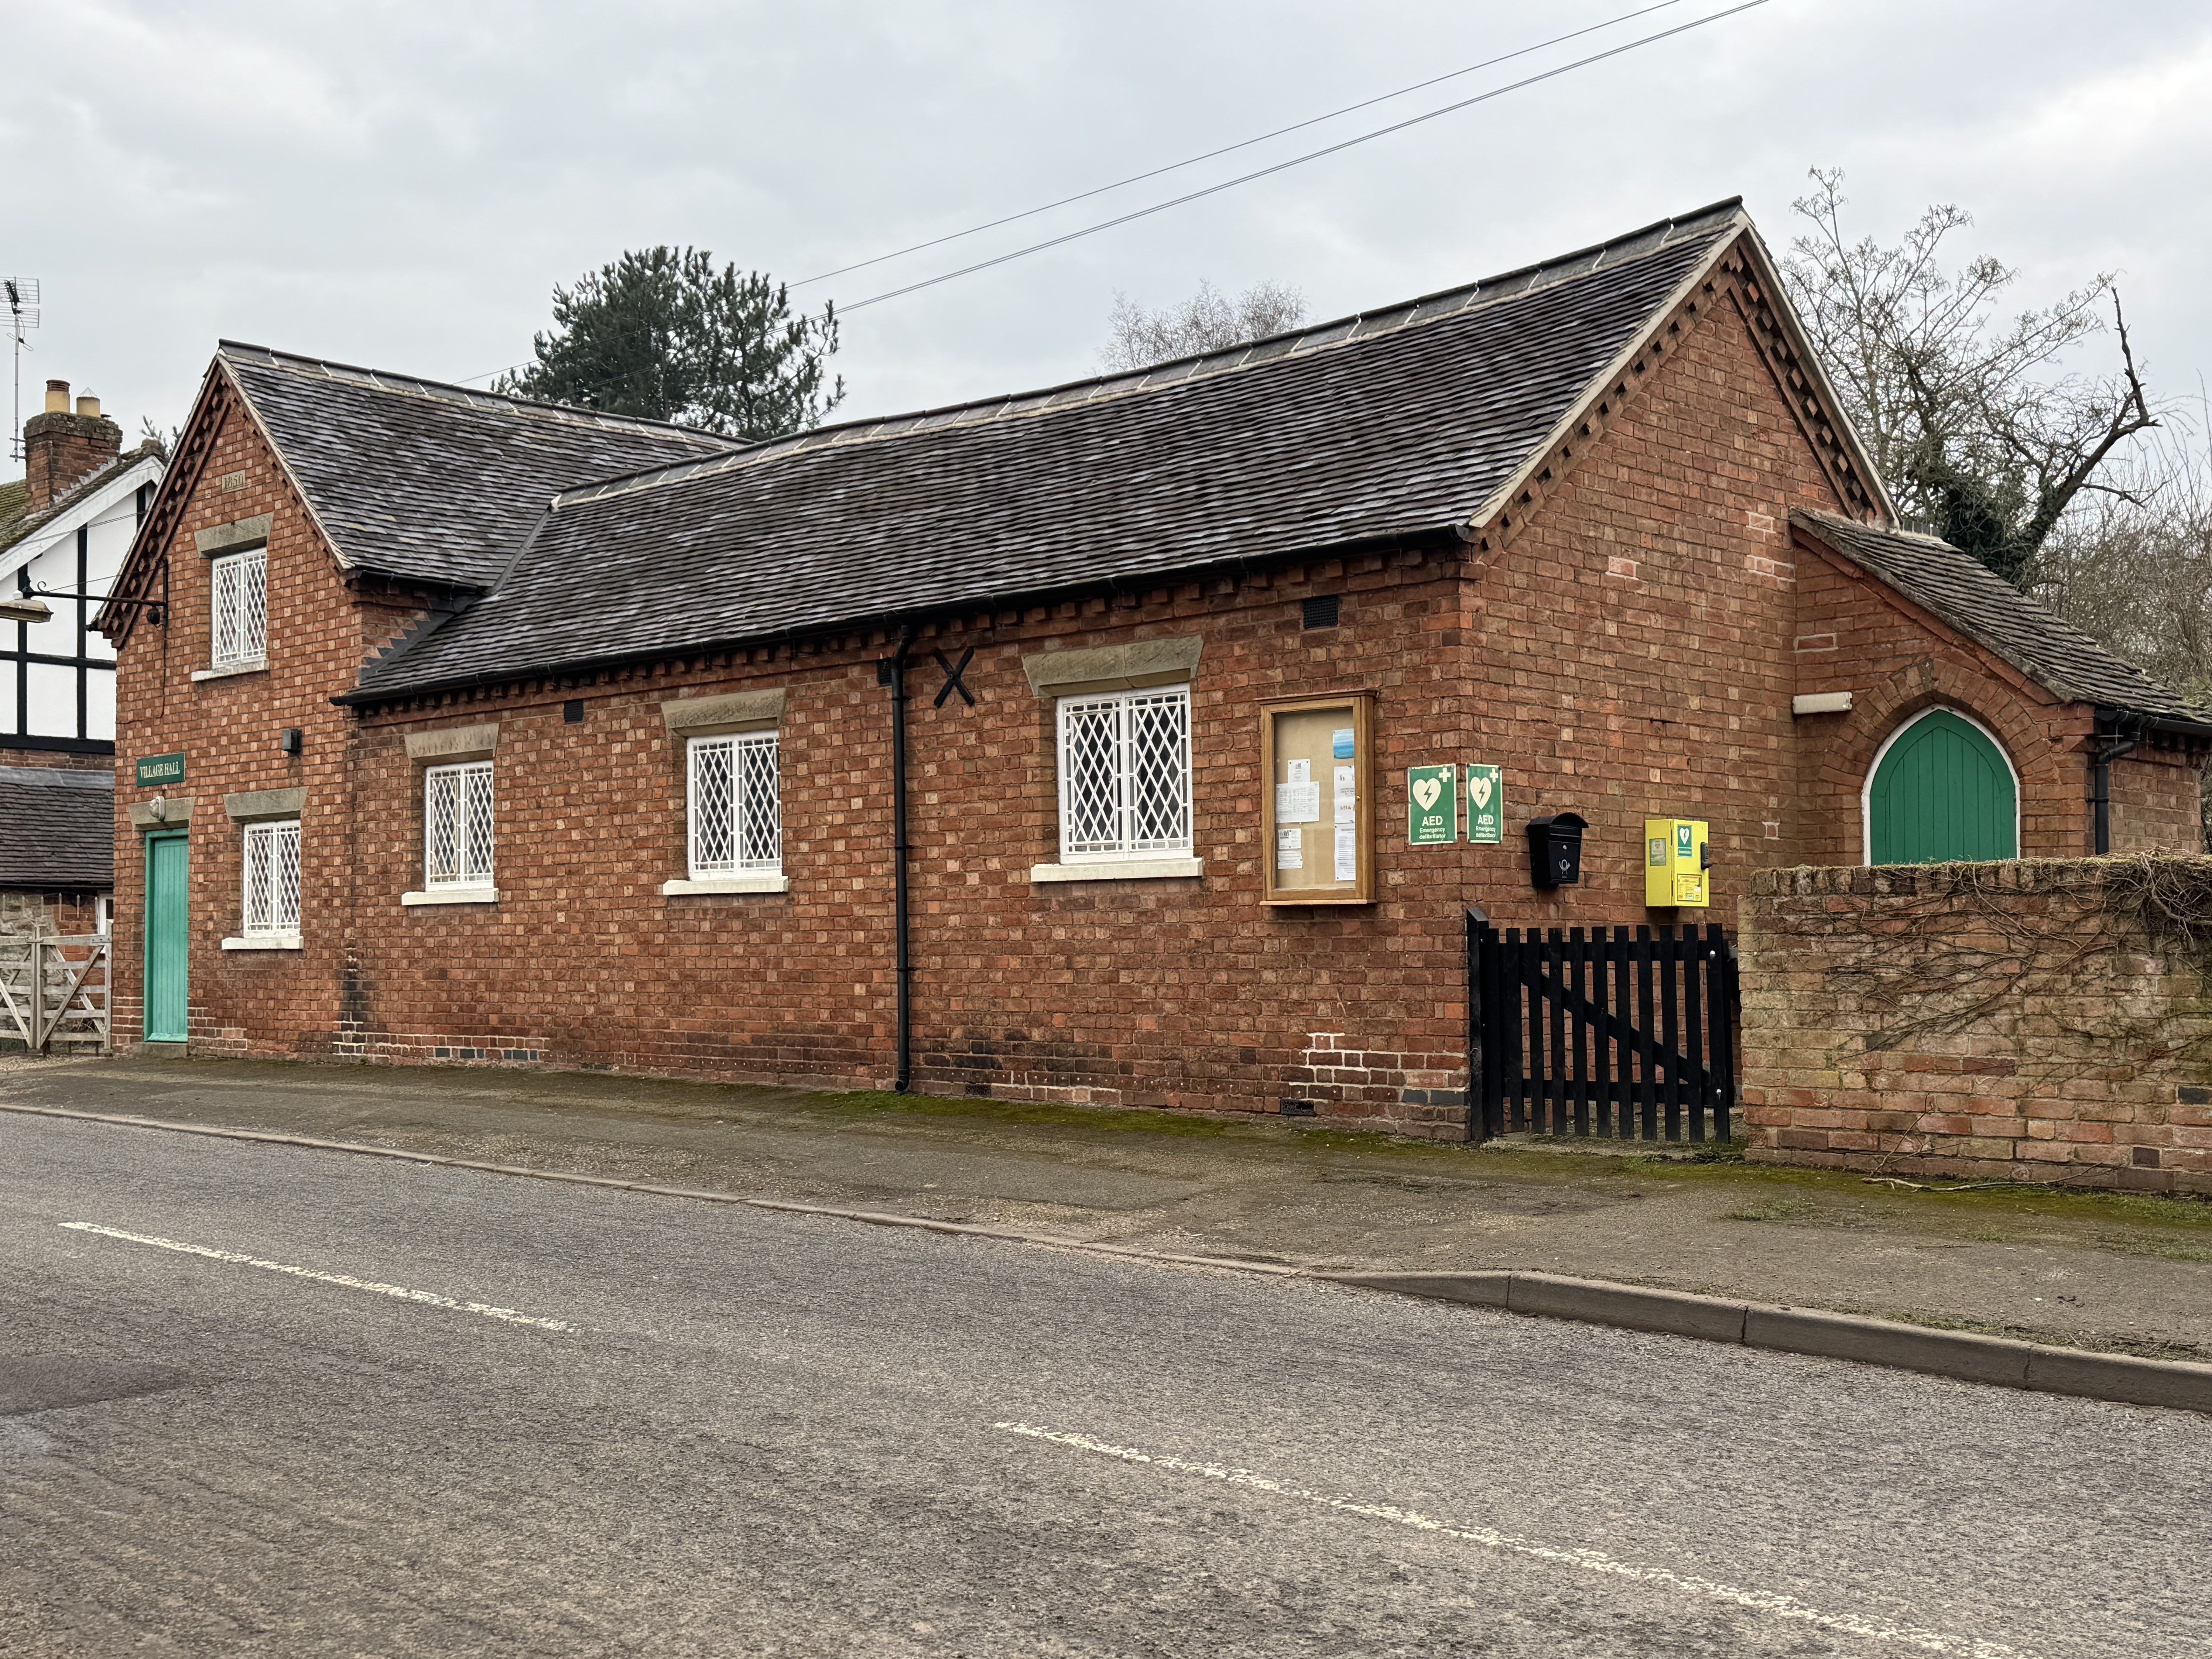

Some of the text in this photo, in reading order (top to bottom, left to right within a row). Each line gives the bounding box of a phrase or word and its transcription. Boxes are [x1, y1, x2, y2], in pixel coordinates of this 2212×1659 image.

[223, 474, 244, 489] 1850
[140, 761, 180, 778] VILLAGE HALL
[1422, 816, 1443, 826] AED
[1477, 815, 1494, 824] AED
